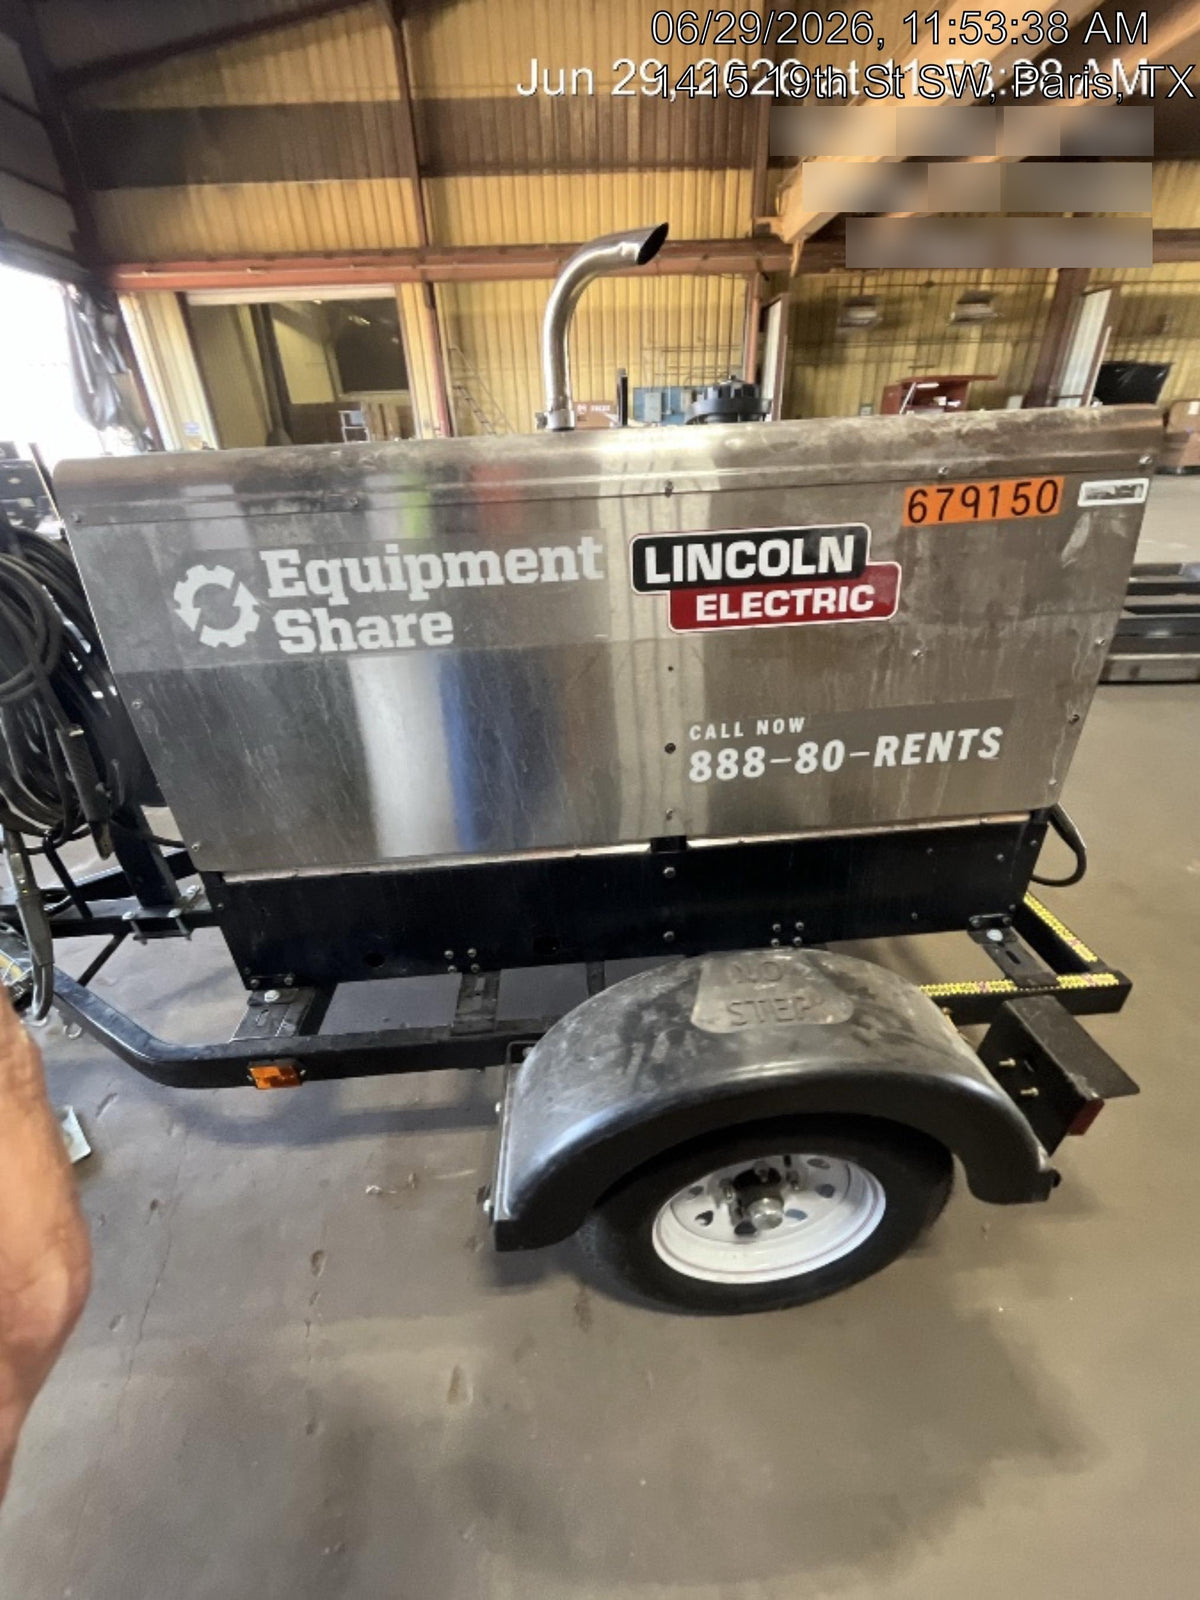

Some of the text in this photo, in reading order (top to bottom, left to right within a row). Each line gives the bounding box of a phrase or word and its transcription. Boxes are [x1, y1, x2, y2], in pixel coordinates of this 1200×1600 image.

[907, 479, 1059, 524] 679150
[260, 536, 605, 606] Equipment
[644, 534, 855, 584] LINCOLN
[696, 584, 875, 622] ELECTRIC
[272, 607, 455, 654] Share
[688, 717, 806, 741] CALL NOW
[688, 726, 1004, 783] 888-80-RENTS
